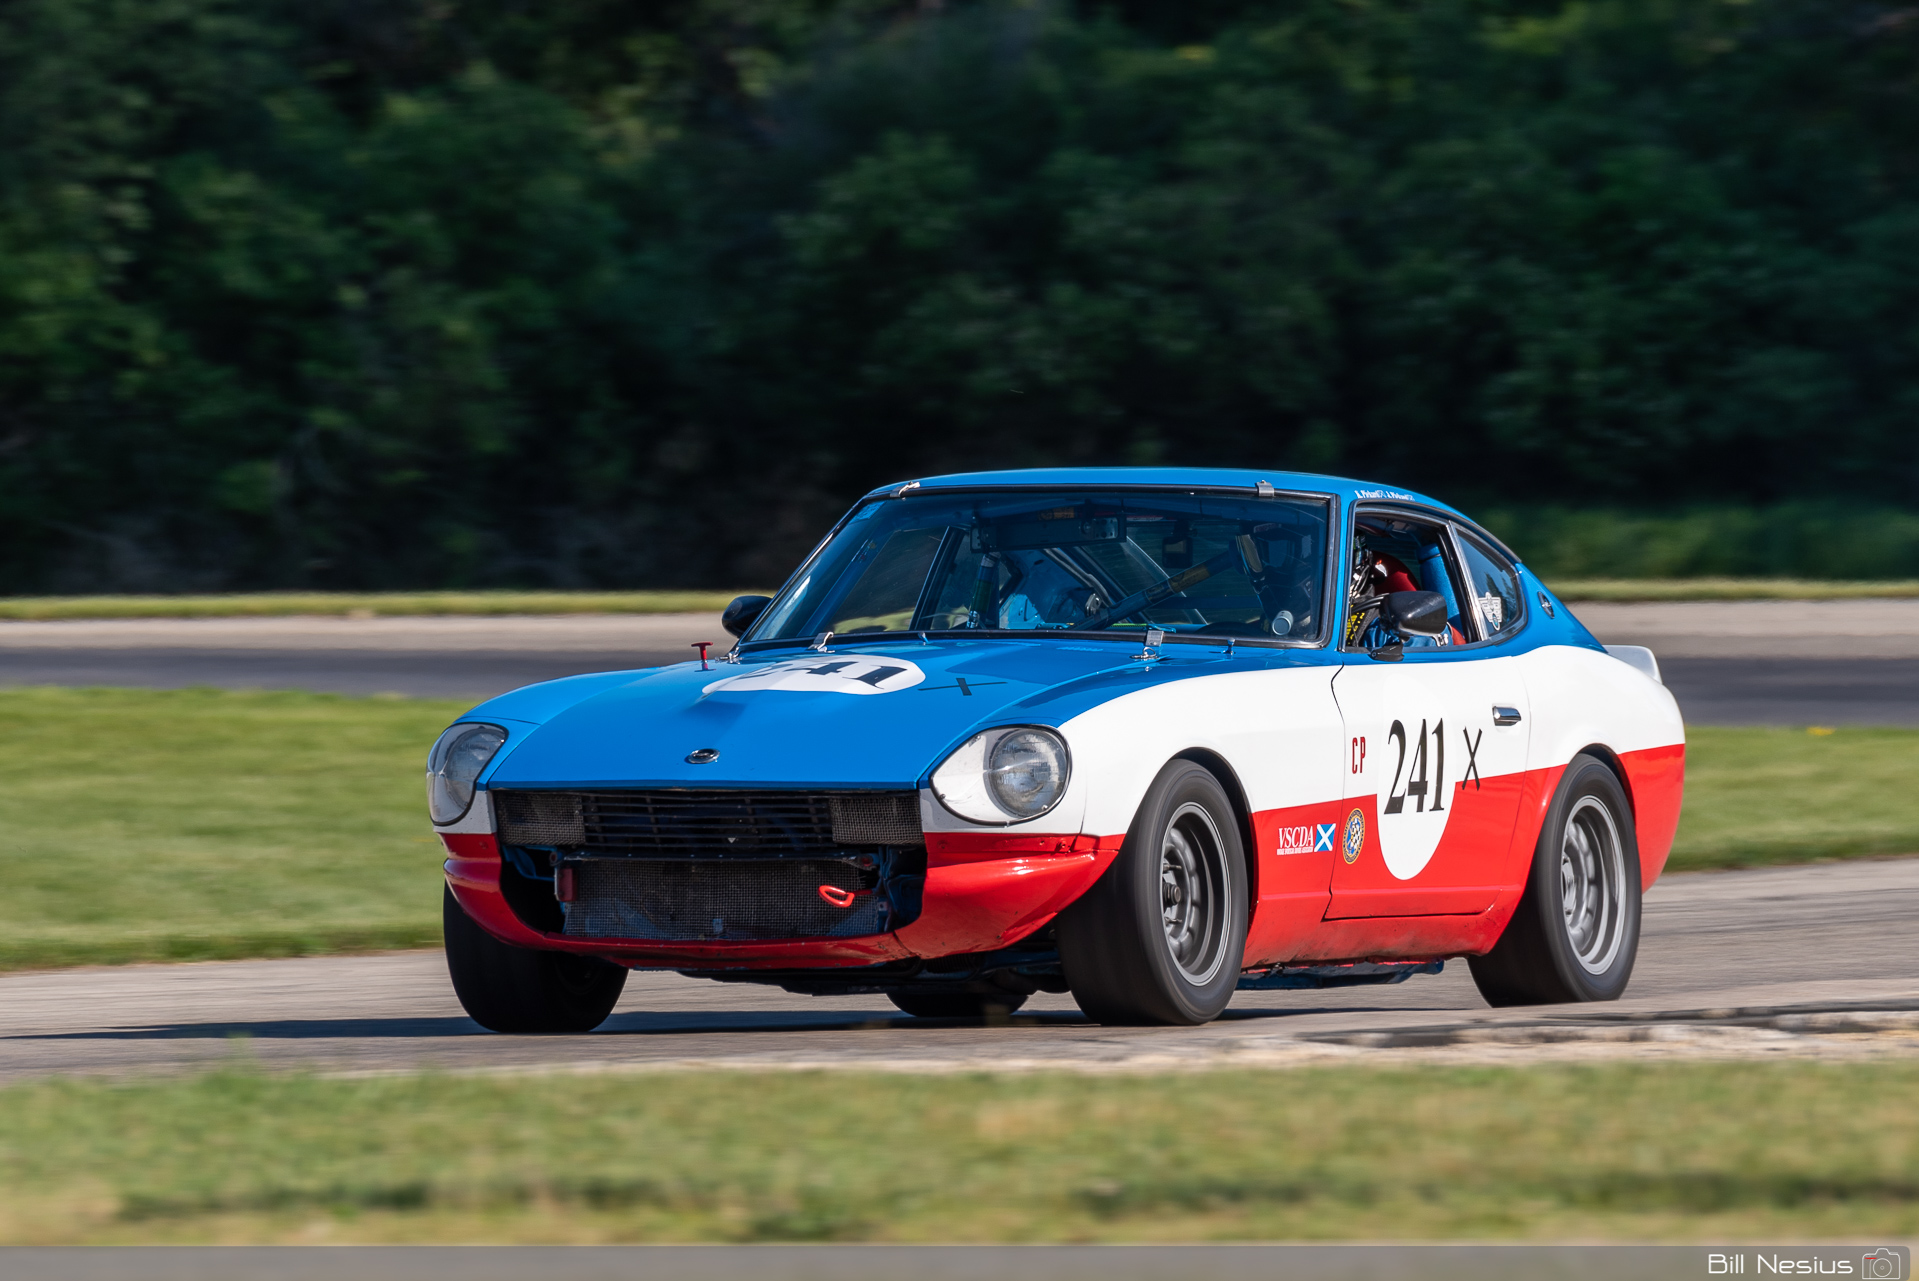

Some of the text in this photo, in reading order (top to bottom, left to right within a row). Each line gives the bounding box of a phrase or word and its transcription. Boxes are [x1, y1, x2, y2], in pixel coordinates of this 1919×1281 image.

[1351, 736, 1366, 774] CP
[1383, 717, 1445, 815] 241
[1461, 726, 1483, 791] X
[1278, 825, 1315, 849] VSCDA
